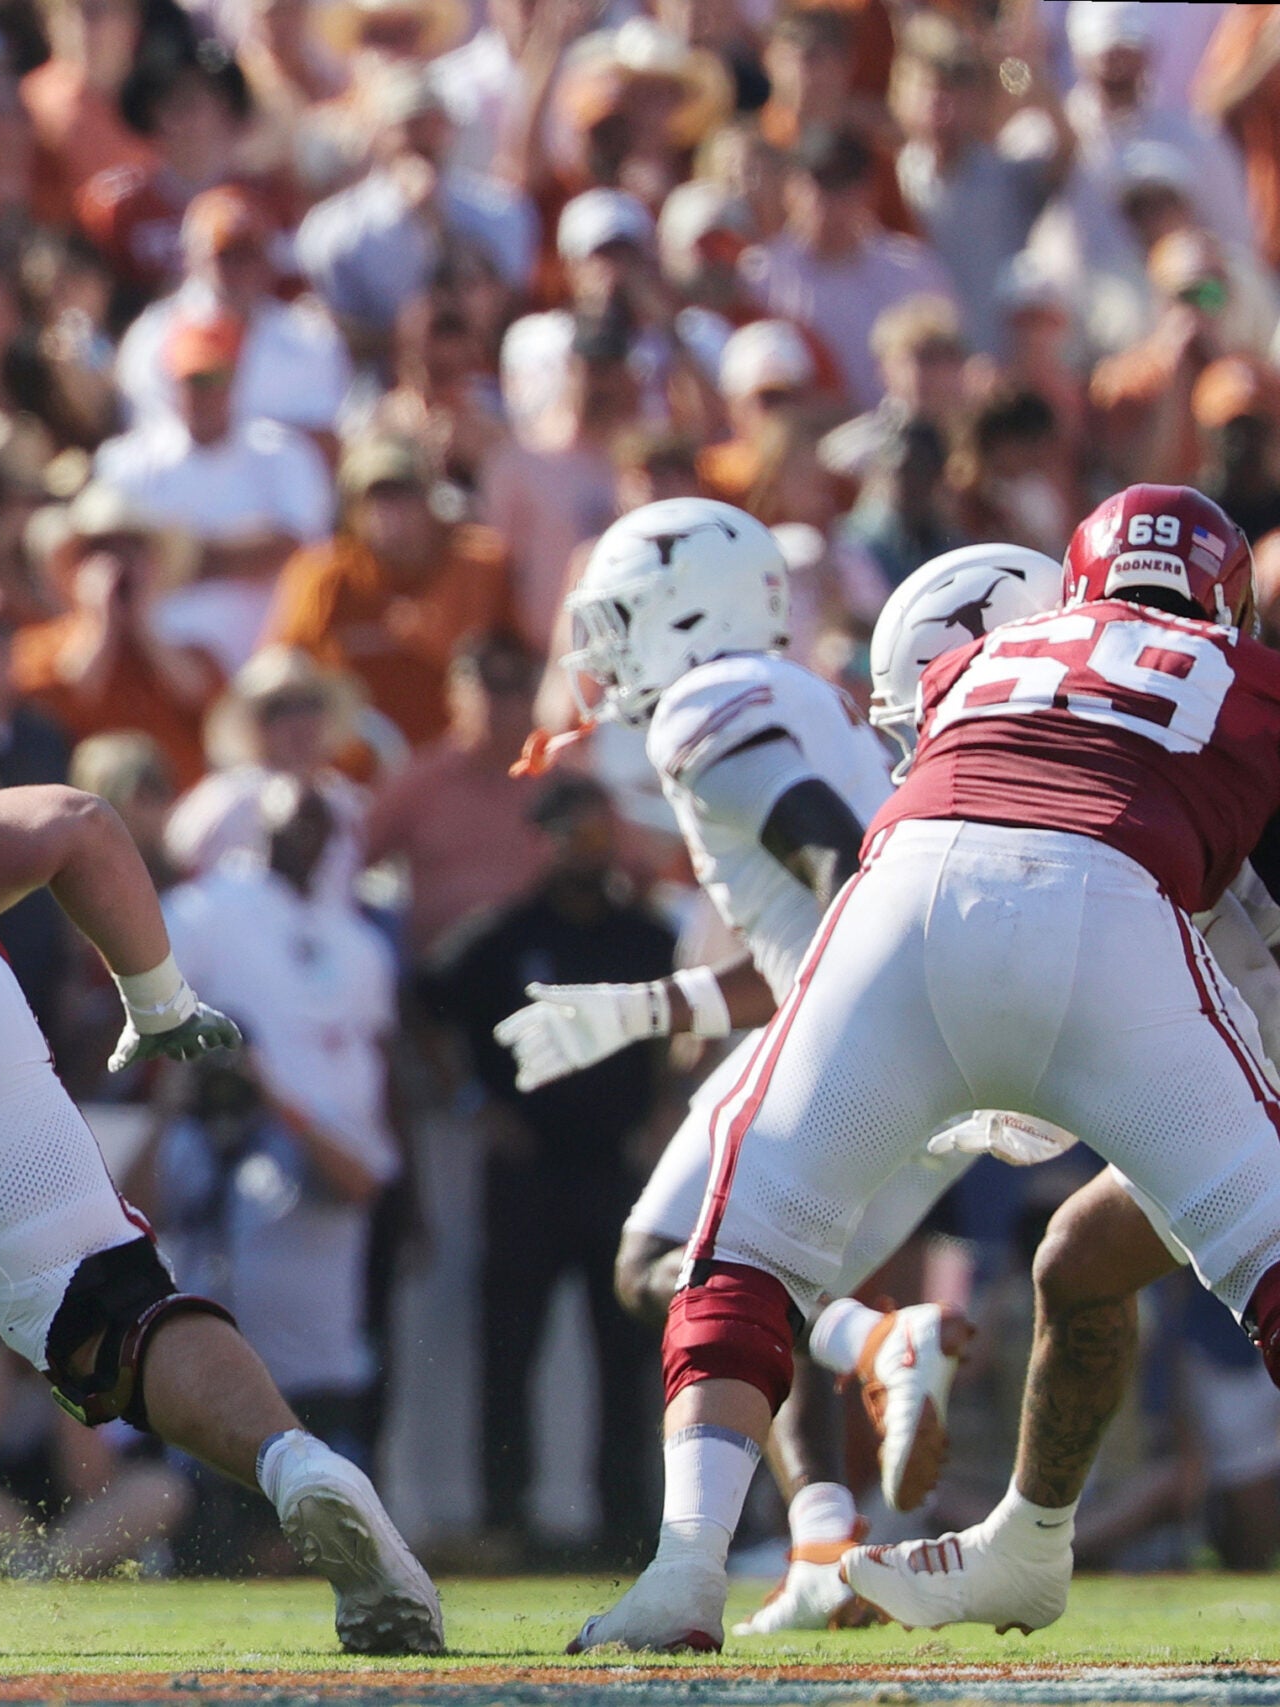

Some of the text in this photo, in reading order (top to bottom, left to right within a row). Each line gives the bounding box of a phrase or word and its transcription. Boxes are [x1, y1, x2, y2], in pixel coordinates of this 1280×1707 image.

[1127, 513, 1181, 547] 69
[1114, 559, 1182, 576] SOONERS
[928, 614, 1236, 755] 69
